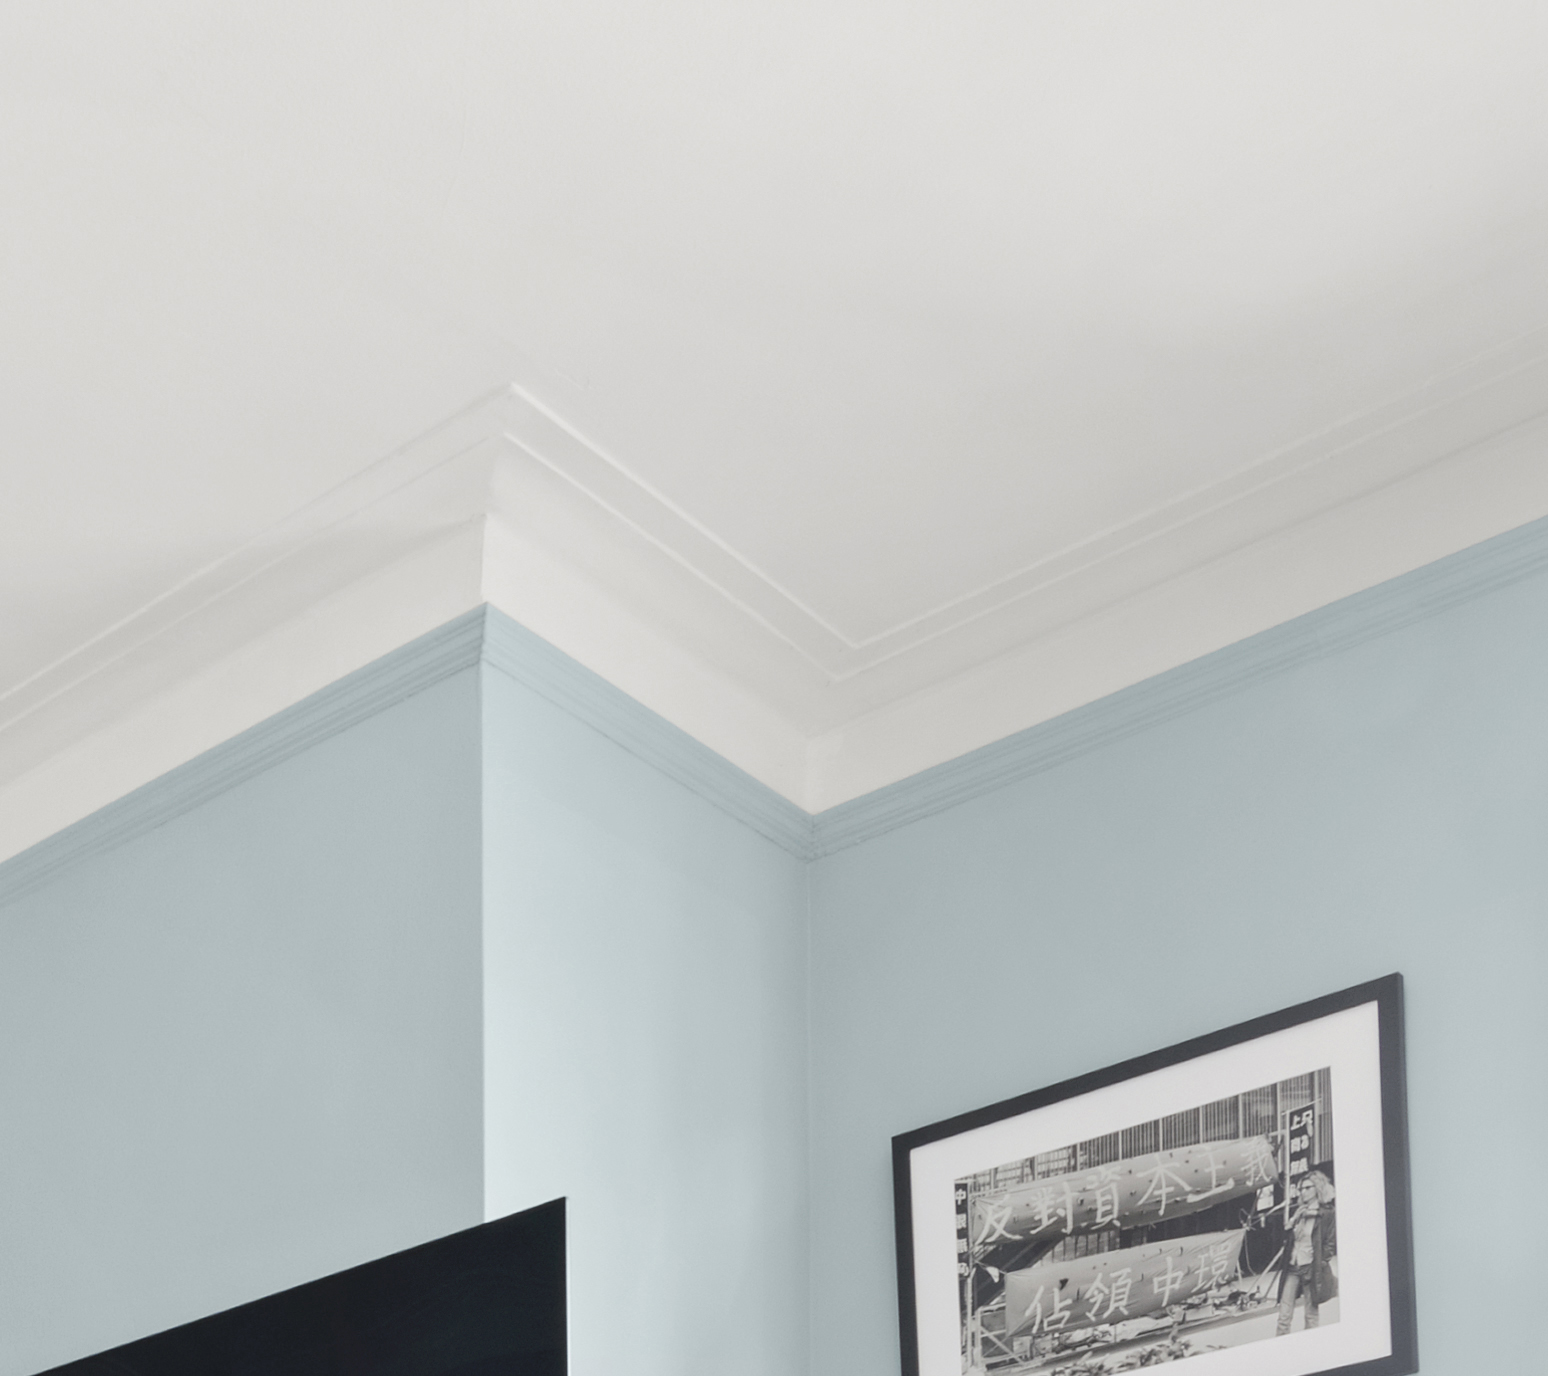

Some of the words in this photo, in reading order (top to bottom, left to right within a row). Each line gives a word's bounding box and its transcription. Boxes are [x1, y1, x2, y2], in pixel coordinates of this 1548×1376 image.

[972, 1147, 1274, 1246] 反對資本主義
[1025, 1247, 1230, 1334] 佔領中環
